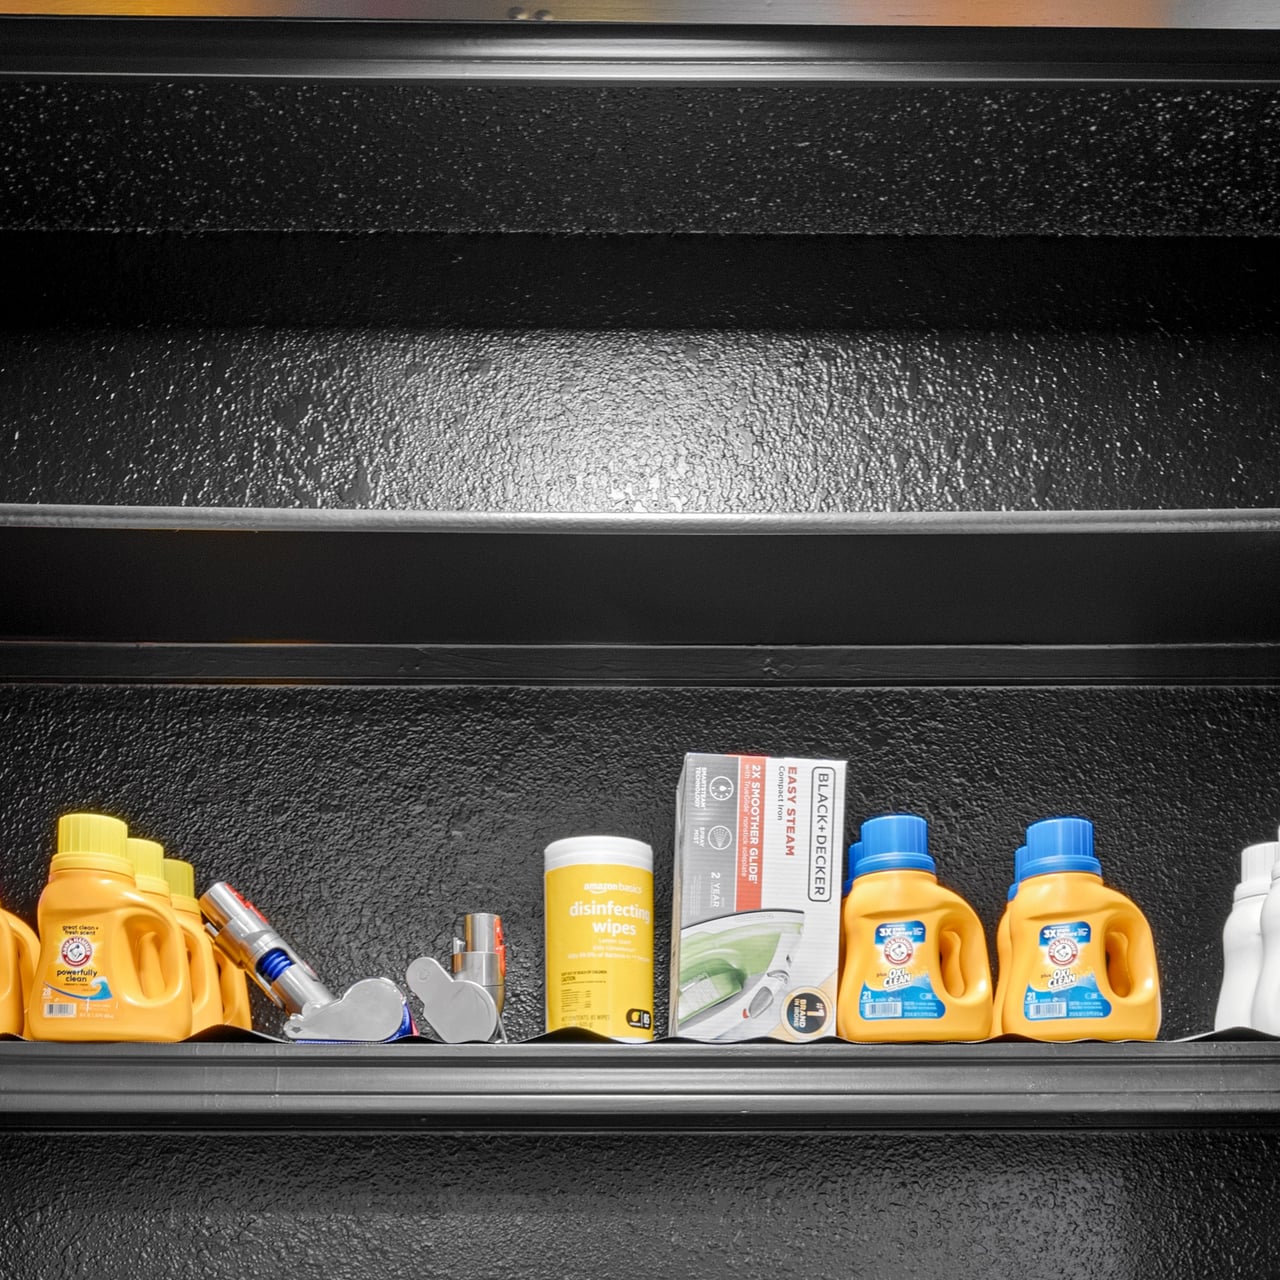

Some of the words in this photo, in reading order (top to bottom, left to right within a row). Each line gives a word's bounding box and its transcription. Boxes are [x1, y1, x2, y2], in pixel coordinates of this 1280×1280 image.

[752, 766, 760, 779] 2X
[787, 767, 797, 803] EASY
[750, 782, 760, 845] SMOOTHER
[786, 808, 796, 856] STEAM
[814, 773, 829, 895] BLACK+DECKER
[712, 883, 720, 908] YEAR
[569, 900, 650, 924] disinfecting
[592, 919, 636, 936] wipes
[56, 969, 97, 977] powerfully
[884, 974, 911, 987] CLEAN
[888, 969, 905, 978] OXI
[1048, 974, 1075, 987] CLEAN
[1053, 969, 1070, 978] OXI
[862, 991, 871, 999] 21
[1027, 992, 1036, 1000] 21
[799, 999, 807, 1028] BRAND
